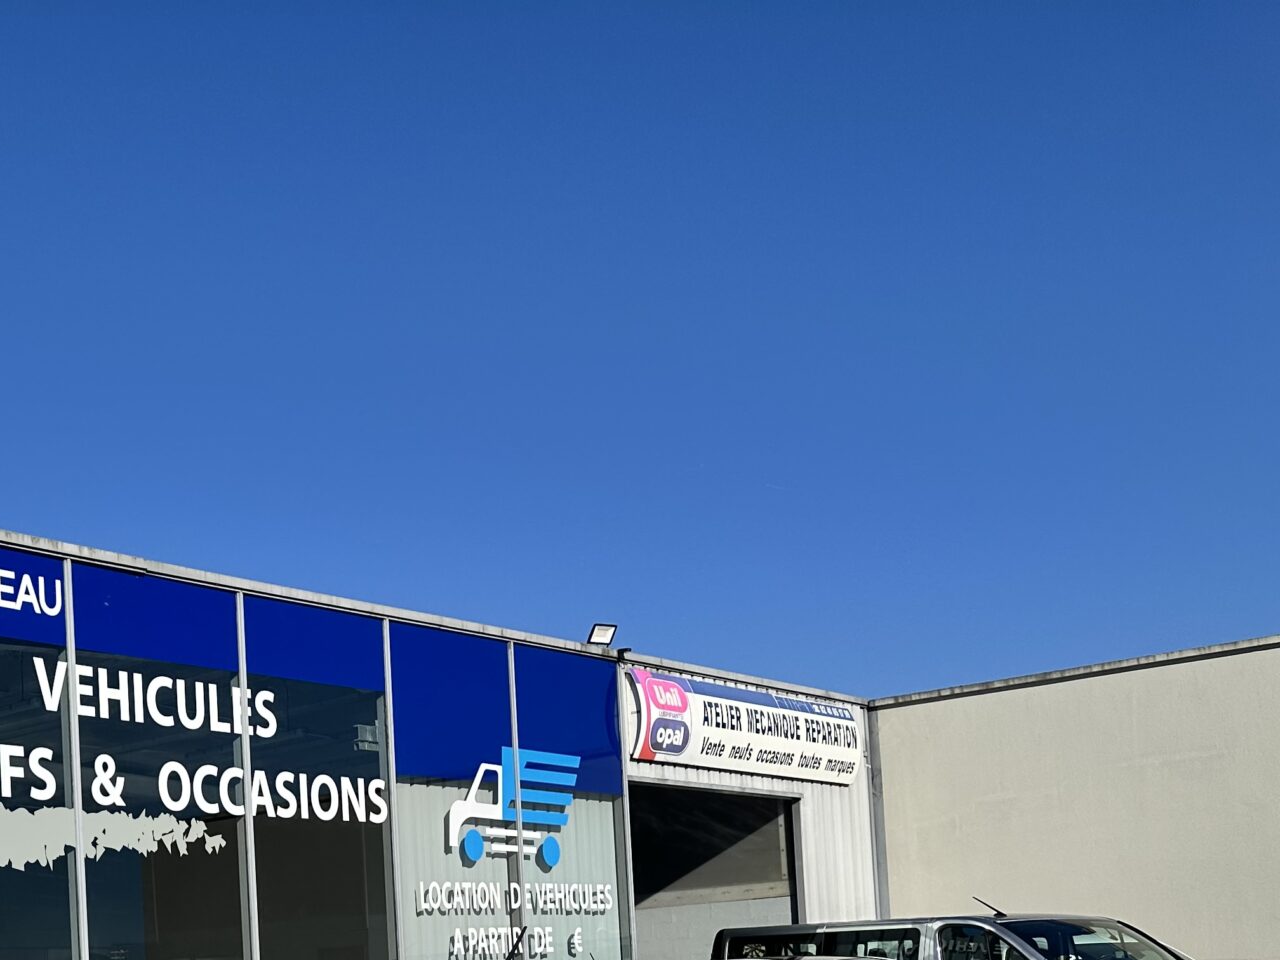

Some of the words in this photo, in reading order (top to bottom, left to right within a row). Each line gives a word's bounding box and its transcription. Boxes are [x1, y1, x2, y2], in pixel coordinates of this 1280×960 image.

[33, 657, 277, 739] VEHICULES
[656, 726, 685, 748] opal
[703, 700, 742, 732] ATELIER
[746, 707, 801, 741] MECANIQUE
[805, 719, 858, 750] REPARATION
[700, 736, 726, 757] Vente
[729, 742, 753, 762] neufs
[756, 749, 795, 768] occasions
[797, 752, 822, 769] toutes
[824, 758, 856, 778] marques
[90, 754, 127, 807] &
[158, 760, 388, 825] OCCASIONS
[419, 880, 501, 910] LOCATION
[535, 883, 613, 911] VEHICULES
[453, 927, 466, 955] A
[468, 926, 524, 955] PARTIR
[534, 926, 554, 953] DE
[573, 926, 584, 953] €
